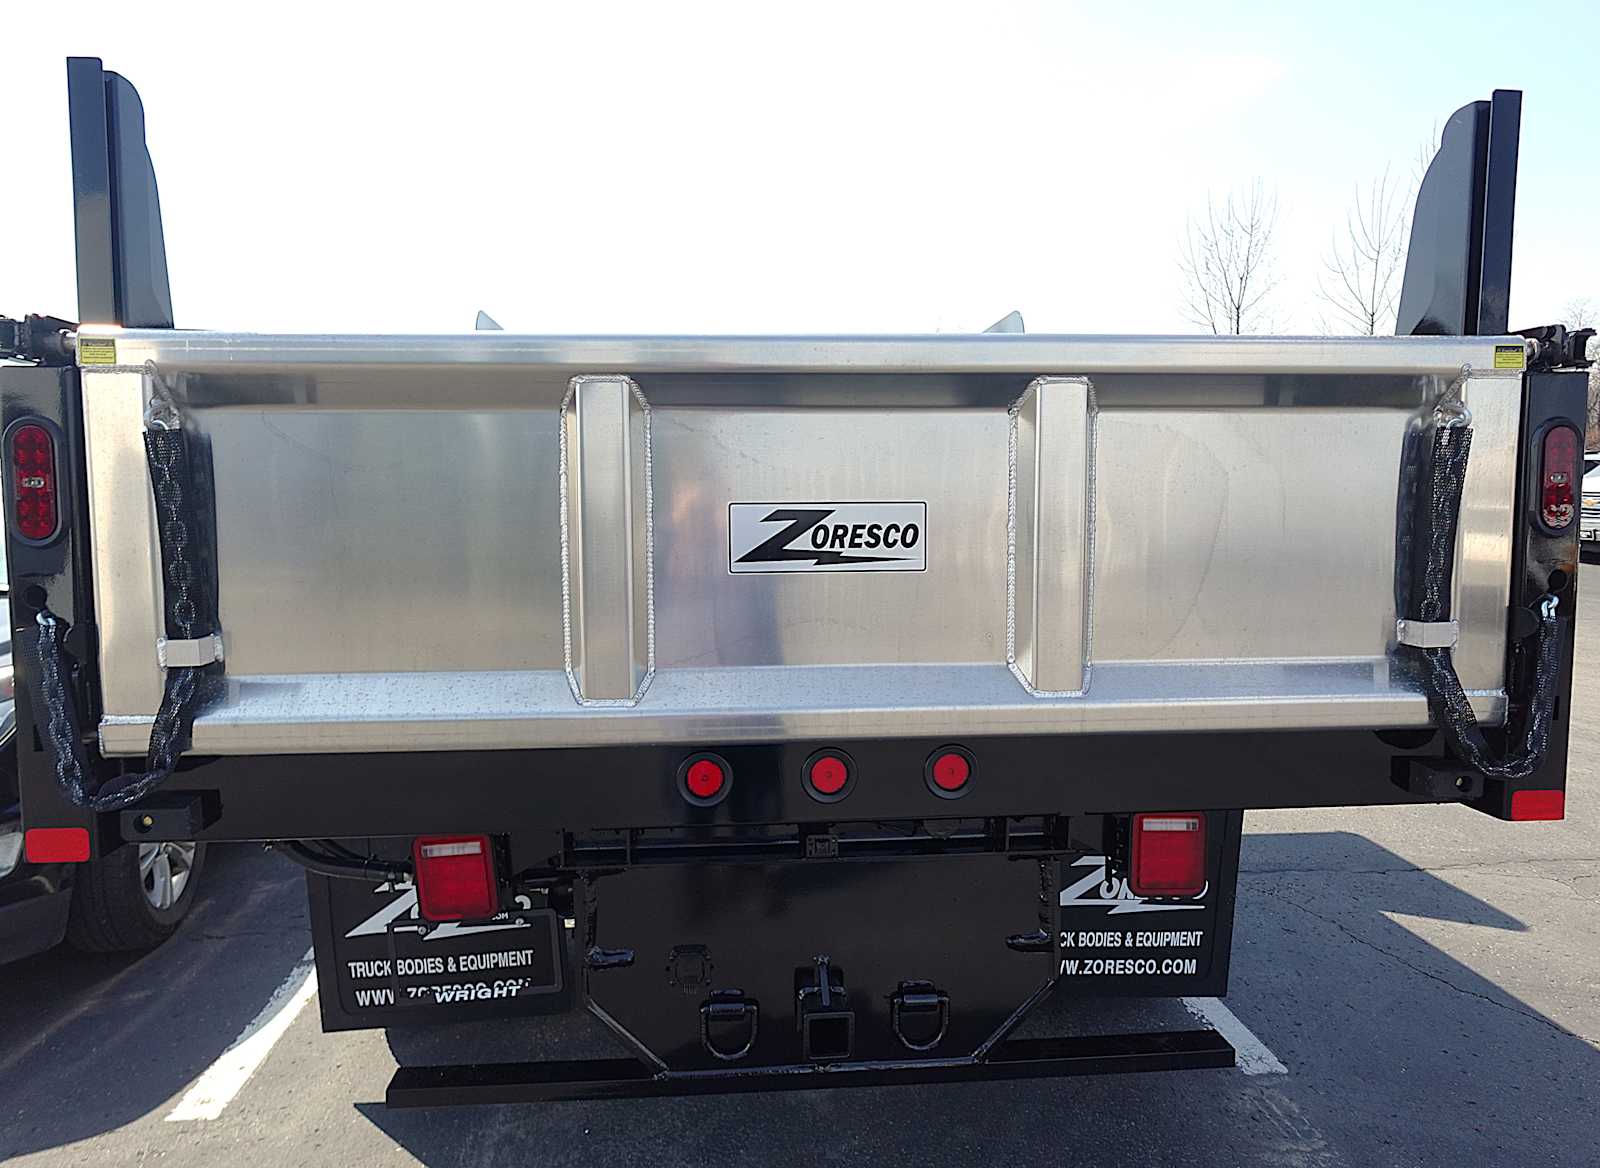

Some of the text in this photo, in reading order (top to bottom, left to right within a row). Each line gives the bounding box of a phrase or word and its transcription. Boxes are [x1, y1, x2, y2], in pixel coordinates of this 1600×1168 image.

[734, 508, 921, 566] ZORESCO
[1079, 931, 1122, 948] BODIES
[1125, 931, 1134, 948] &
[1136, 931, 1204, 948] EQUIPMENT
[347, 949, 534, 979] TRUCK BODIES & EQUIPMENT
[435, 984, 522, 1004] WRIGHT
